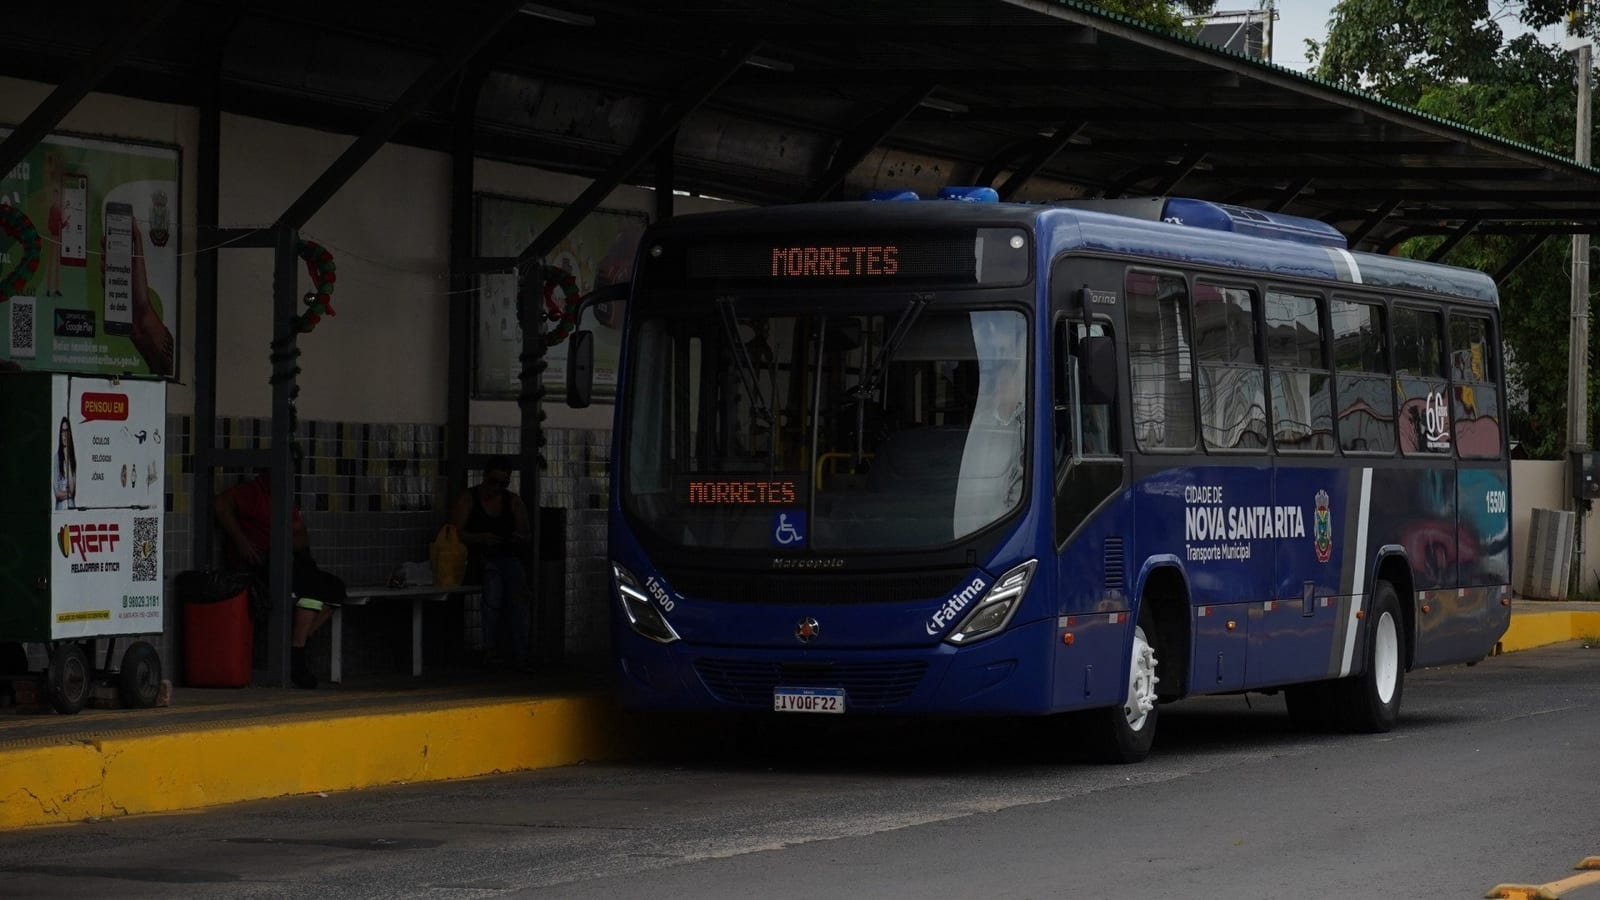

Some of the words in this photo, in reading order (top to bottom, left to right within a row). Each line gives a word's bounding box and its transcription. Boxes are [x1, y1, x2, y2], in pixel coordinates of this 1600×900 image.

[771, 246, 899, 276] MORRETES
[1090, 292, 1116, 304] orino
[65, 320, 83, 334] Google
[83, 321, 93, 334] Play
[85, 400, 112, 413] PENSOU
[113, 401, 125, 414] EM
[92, 435, 110, 446] ÓCULOS
[689, 482, 796, 503] MORRETES
[1185, 486, 1212, 504] CIDADE
[1212, 486, 1223, 504] DE
[1486, 490, 1506, 513] 15500
[1185, 506, 1227, 541] NOVA
[1228, 505, 1274, 541] SANTA
[1274, 505, 1306, 539] RITA
[773, 557, 844, 569] Marcopolo
[1186, 543, 1221, 565] Transporte
[1222, 541, 1251, 563] Municipal
[645, 576, 675, 612] 15500
[931, 578, 986, 629] Fátima
